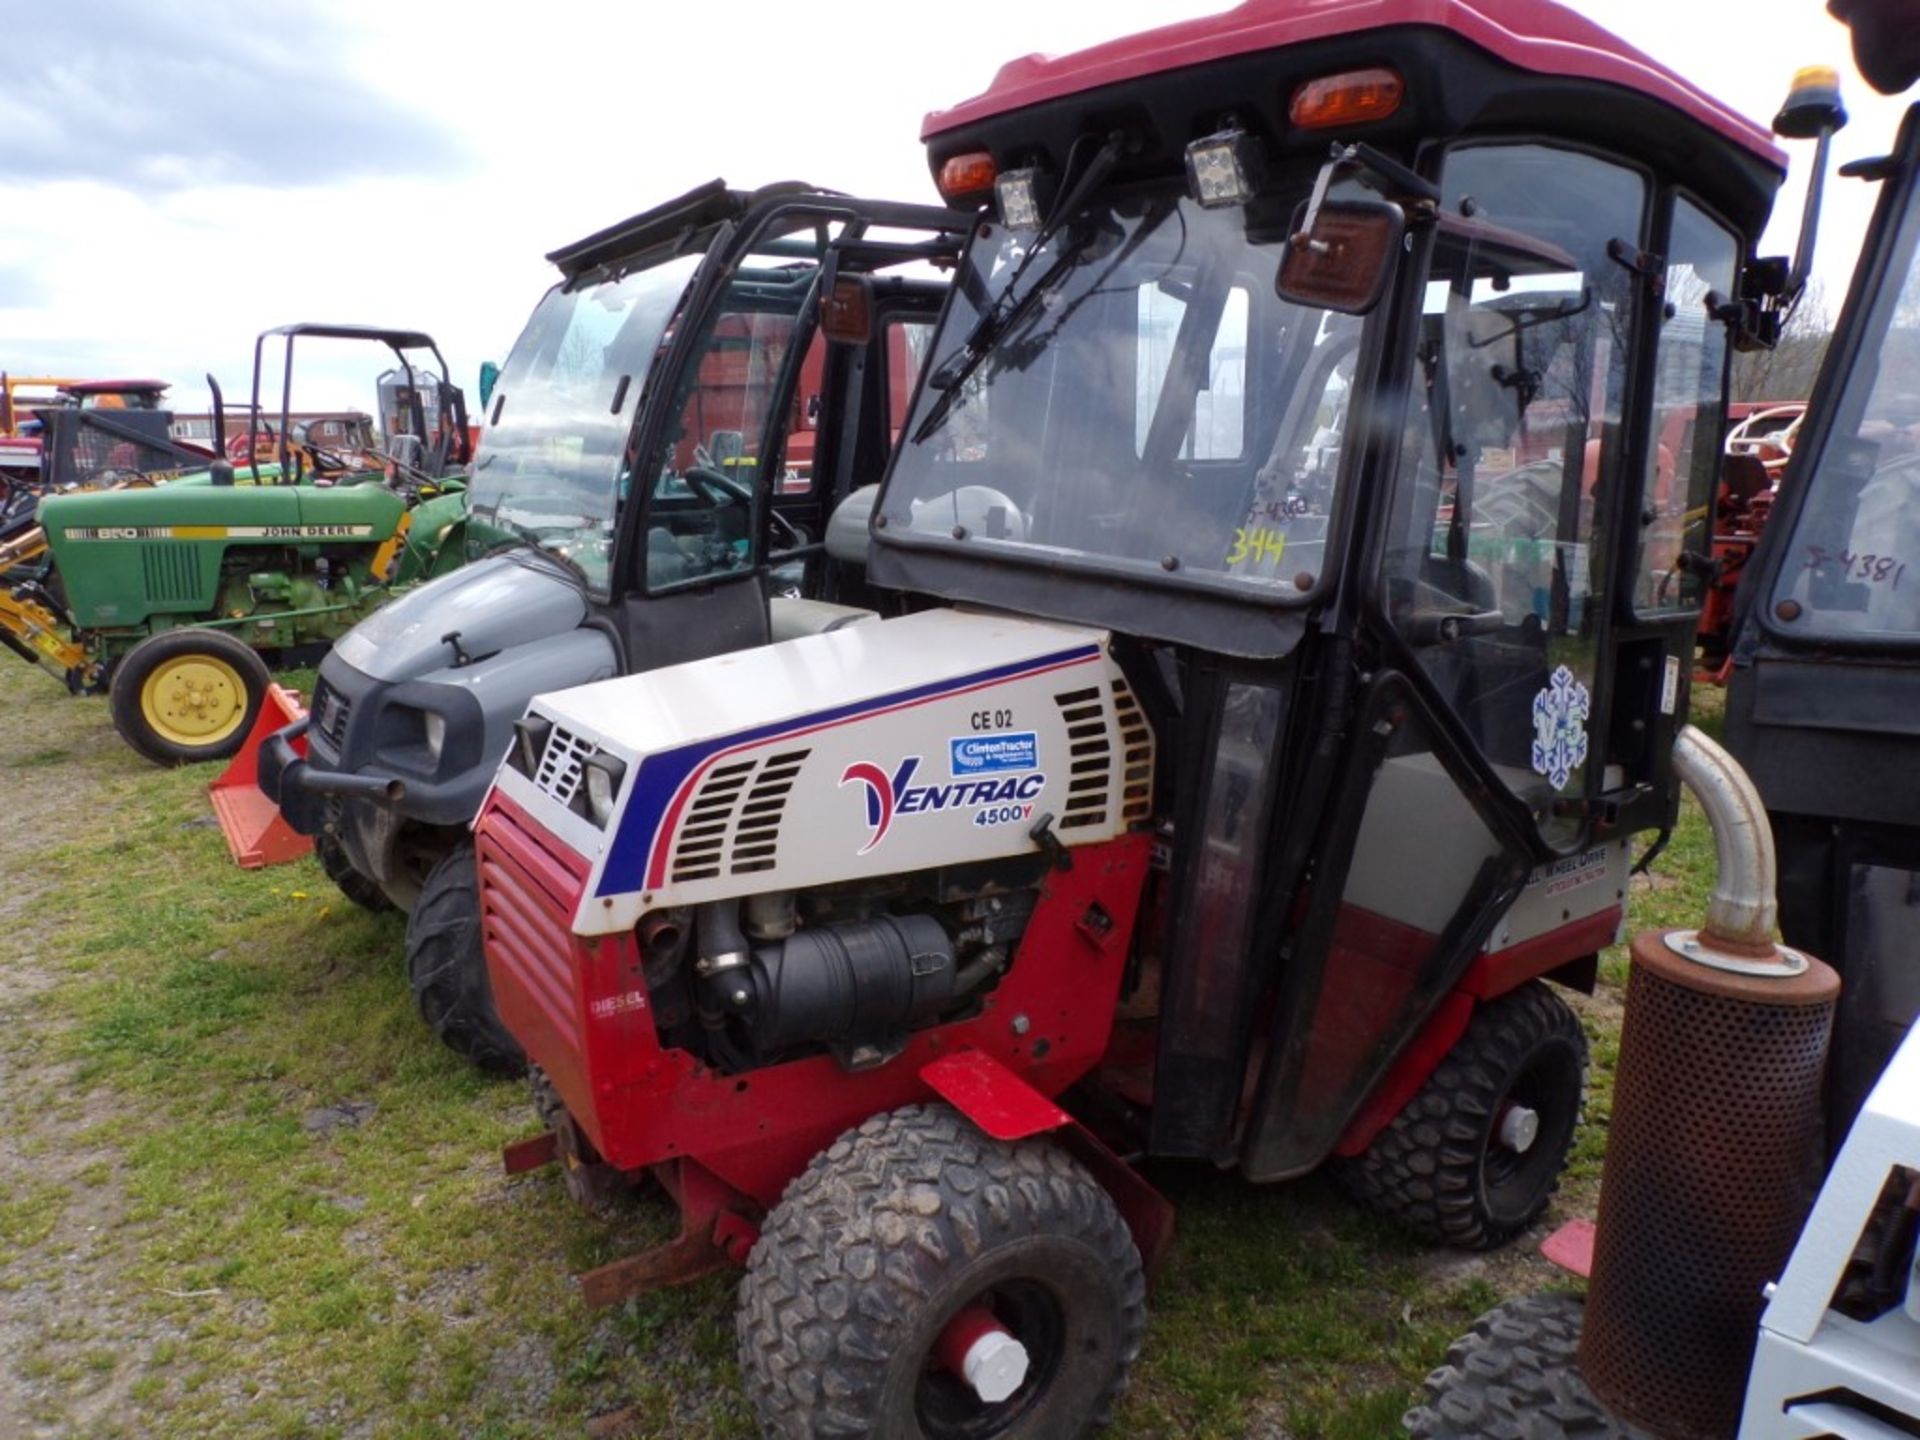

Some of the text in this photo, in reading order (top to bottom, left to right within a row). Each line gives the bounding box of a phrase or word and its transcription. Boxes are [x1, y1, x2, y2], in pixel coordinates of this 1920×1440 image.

[98, 527, 137, 539] 850
[261, 525, 354, 538] JOHN DEERE
[1225, 527, 1287, 566] 344
[971, 709, 1013, 730] CE 02
[839, 756, 1045, 855] VENTRAC
[974, 805, 1033, 825] 4500Y
[590, 991, 645, 1015] DIESEL
